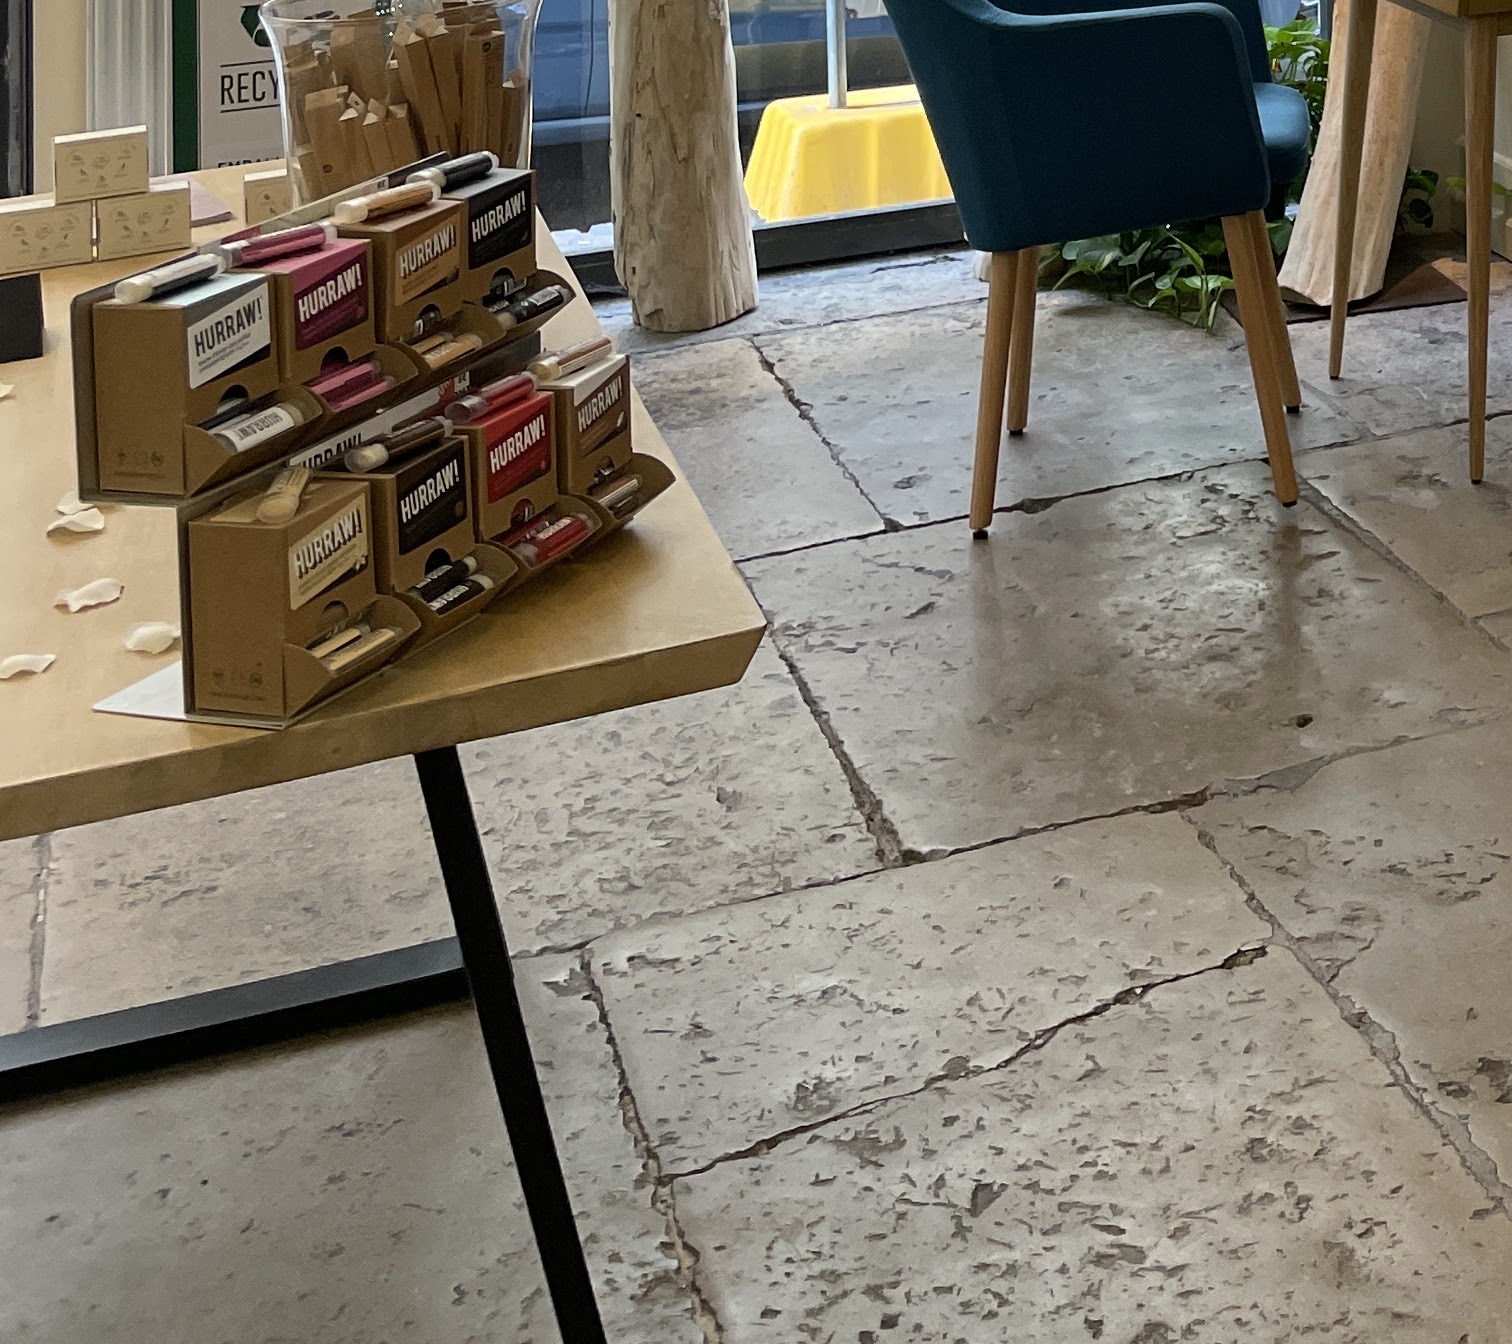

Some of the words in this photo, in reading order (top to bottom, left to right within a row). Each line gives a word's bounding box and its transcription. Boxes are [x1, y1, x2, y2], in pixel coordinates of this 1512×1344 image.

[220, 69, 281, 106] RECY
[471, 190, 527, 243] HURRAW!
[399, 223, 457, 279] HURRAW!
[298, 263, 363, 323] HURRAW!
[194, 296, 263, 357] HURRAW!
[577, 375, 624, 432] HURRAW!
[489, 414, 547, 474] HURRAW!
[400, 458, 460, 524] HURRAW!
[293, 507, 363, 579] HURRAW!
